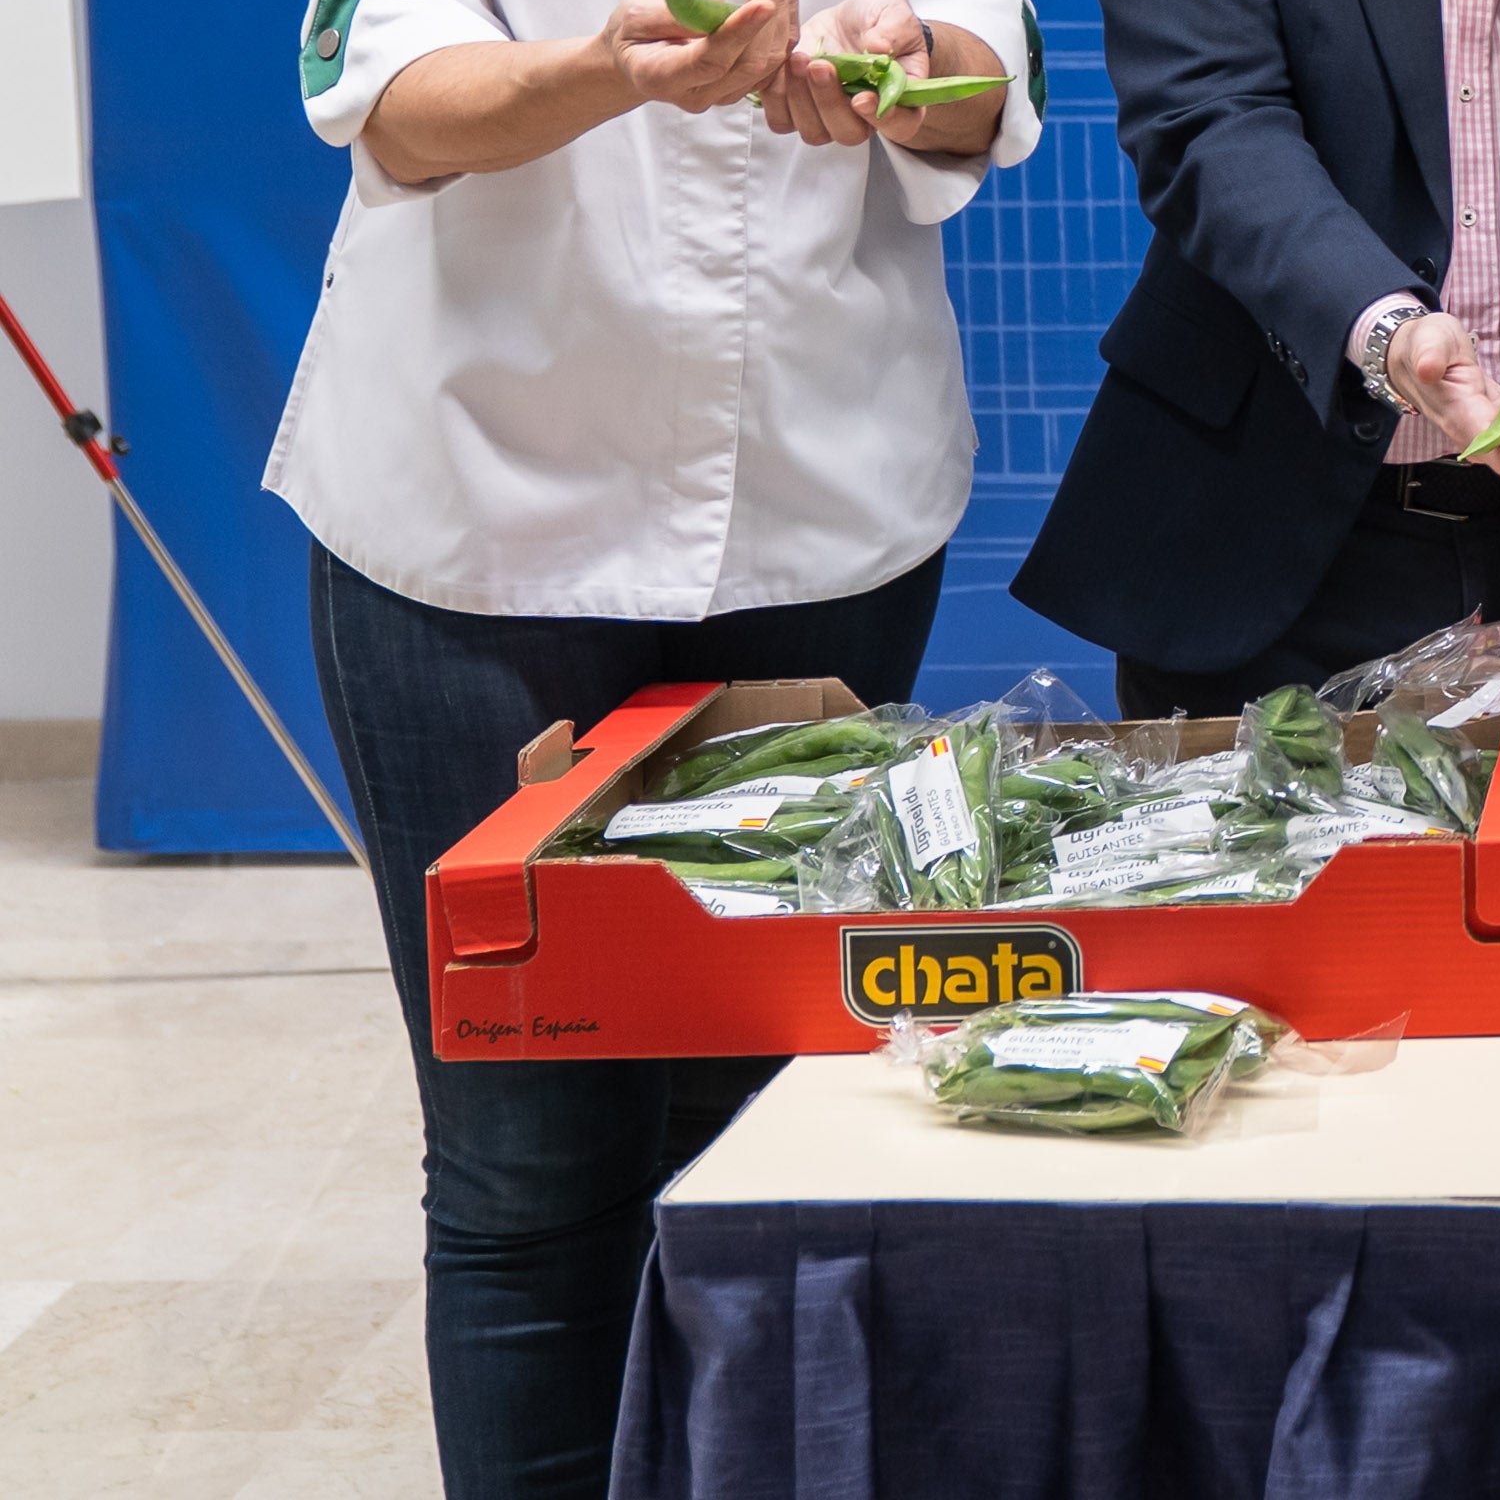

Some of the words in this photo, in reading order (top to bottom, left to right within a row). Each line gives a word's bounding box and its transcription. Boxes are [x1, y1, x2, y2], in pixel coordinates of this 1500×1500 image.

[619, 811, 701, 822] GUISANTES
[902, 785, 932, 856] agroejido
[926, 788, 950, 847] GUISANTES
[1066, 833, 1145, 863] GUISANTES
[861, 942, 1063, 1006] chata
[531, 1016, 600, 1041] España
[1008, 1035, 1096, 1046] GUISANTES
